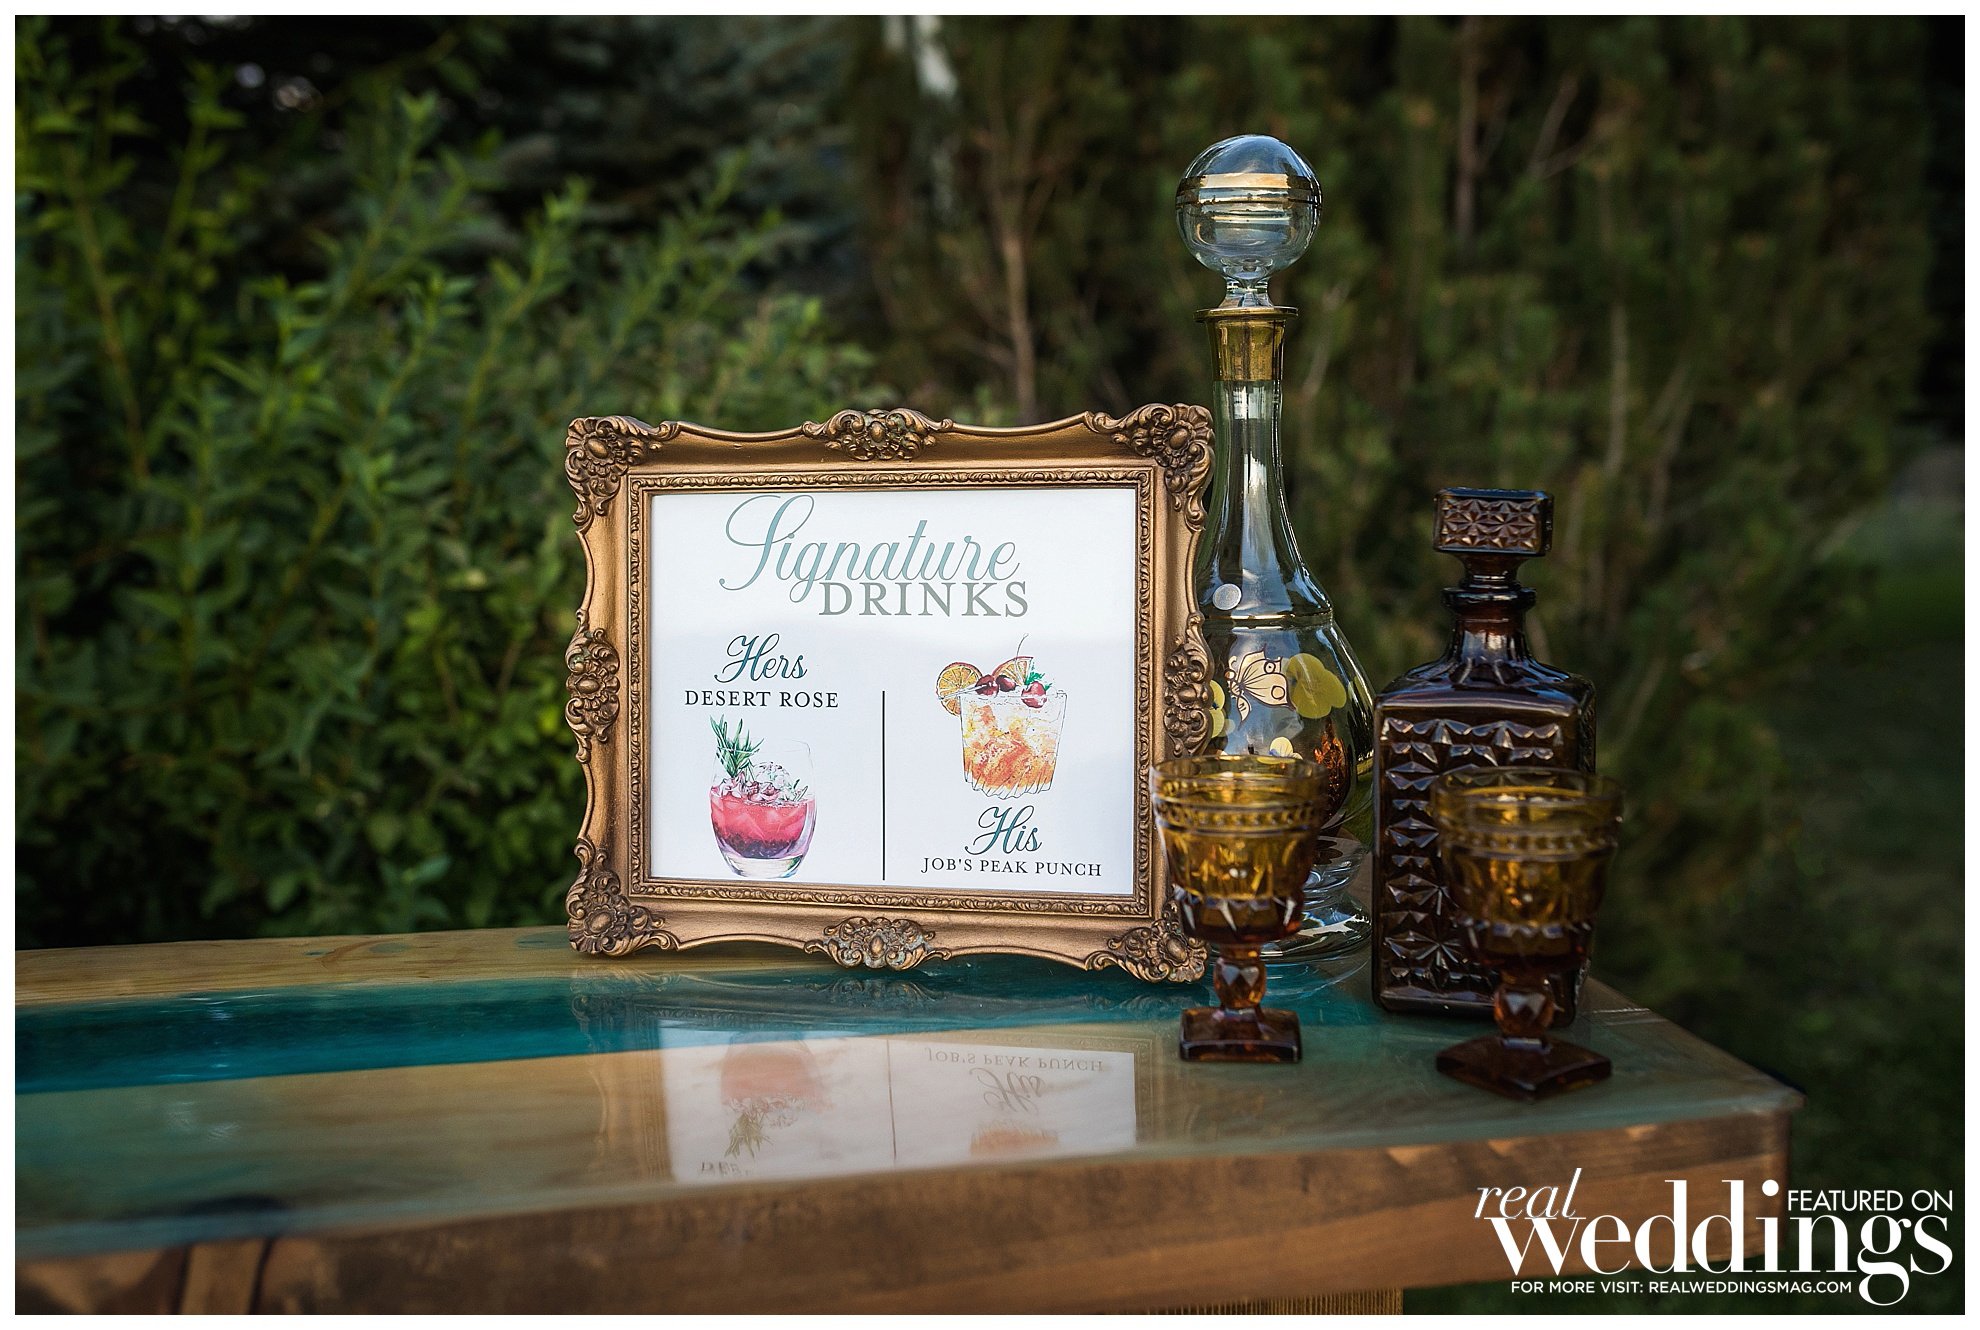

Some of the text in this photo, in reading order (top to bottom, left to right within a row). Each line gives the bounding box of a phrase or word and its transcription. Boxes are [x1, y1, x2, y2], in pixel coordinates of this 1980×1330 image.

[718, 494, 1020, 603] Signature
[818, 581, 1029, 618] DRINKS
[714, 634, 807, 683] Hers
[684, 691, 839, 708] DESERT ROSE
[964, 805, 1042, 855] His
[921, 857, 1102, 877] JOB'S PEAK PUNCH
